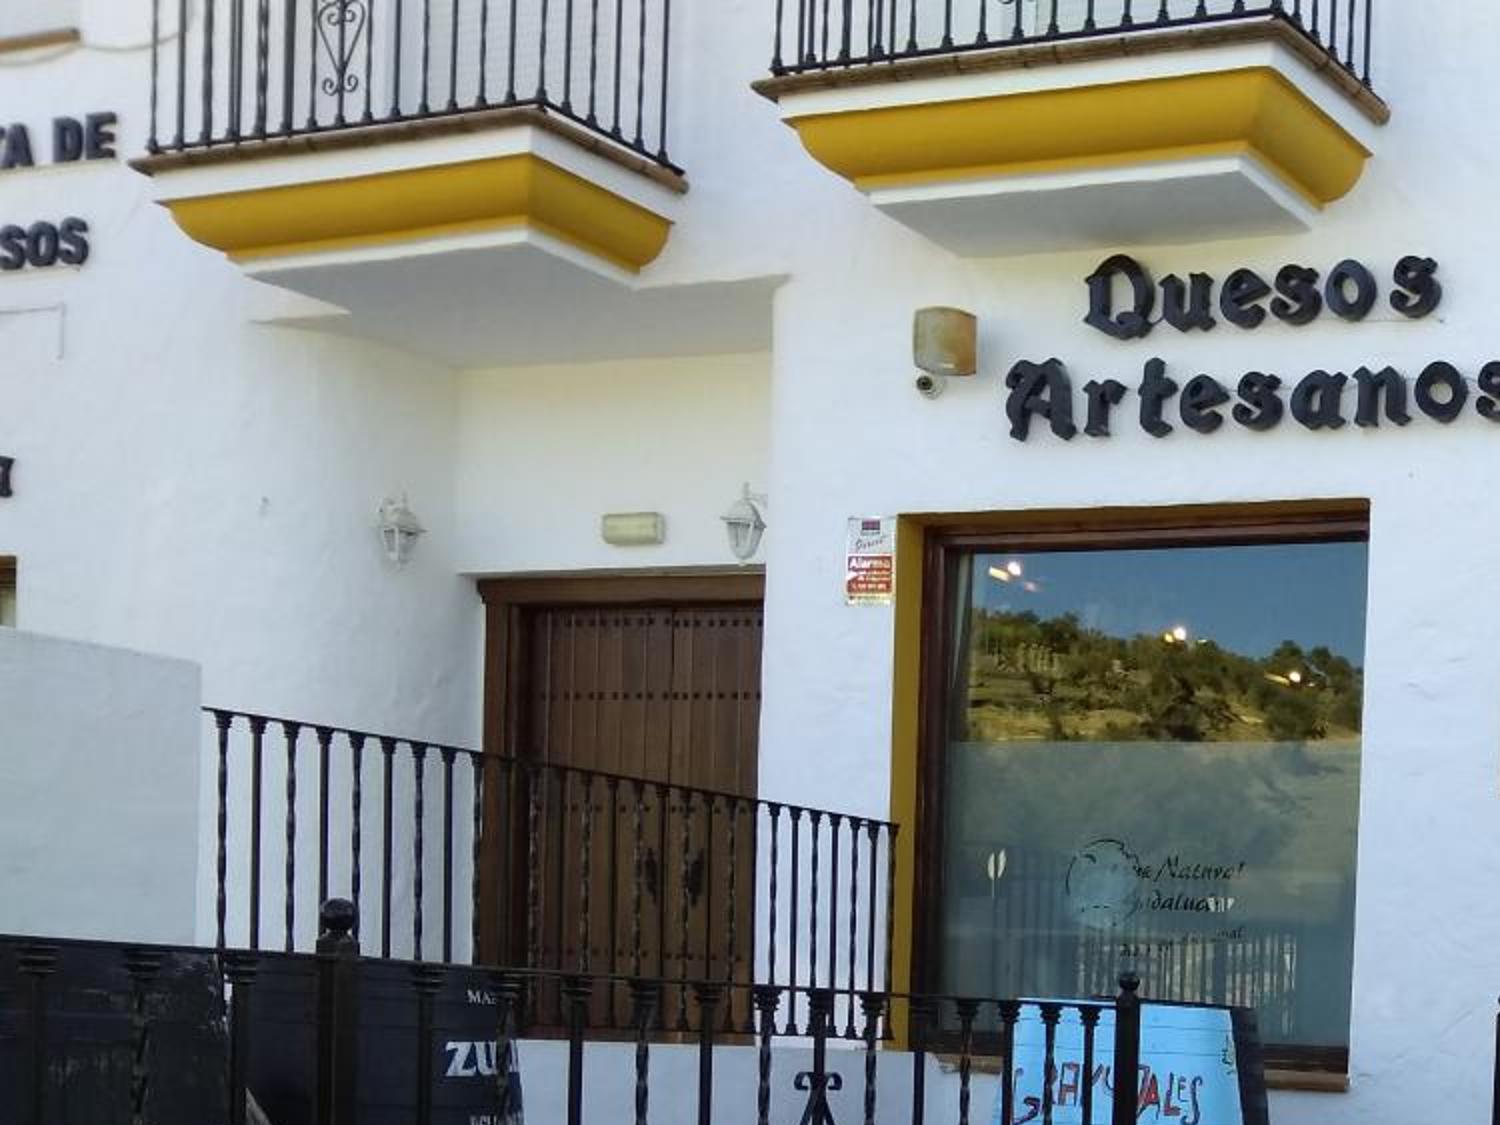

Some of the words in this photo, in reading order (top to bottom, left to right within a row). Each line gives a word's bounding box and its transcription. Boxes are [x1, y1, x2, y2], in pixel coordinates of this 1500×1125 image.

[0, 122, 35, 168] A
[52, 112, 117, 163] DE
[1083, 253, 1442, 341] Quesos
